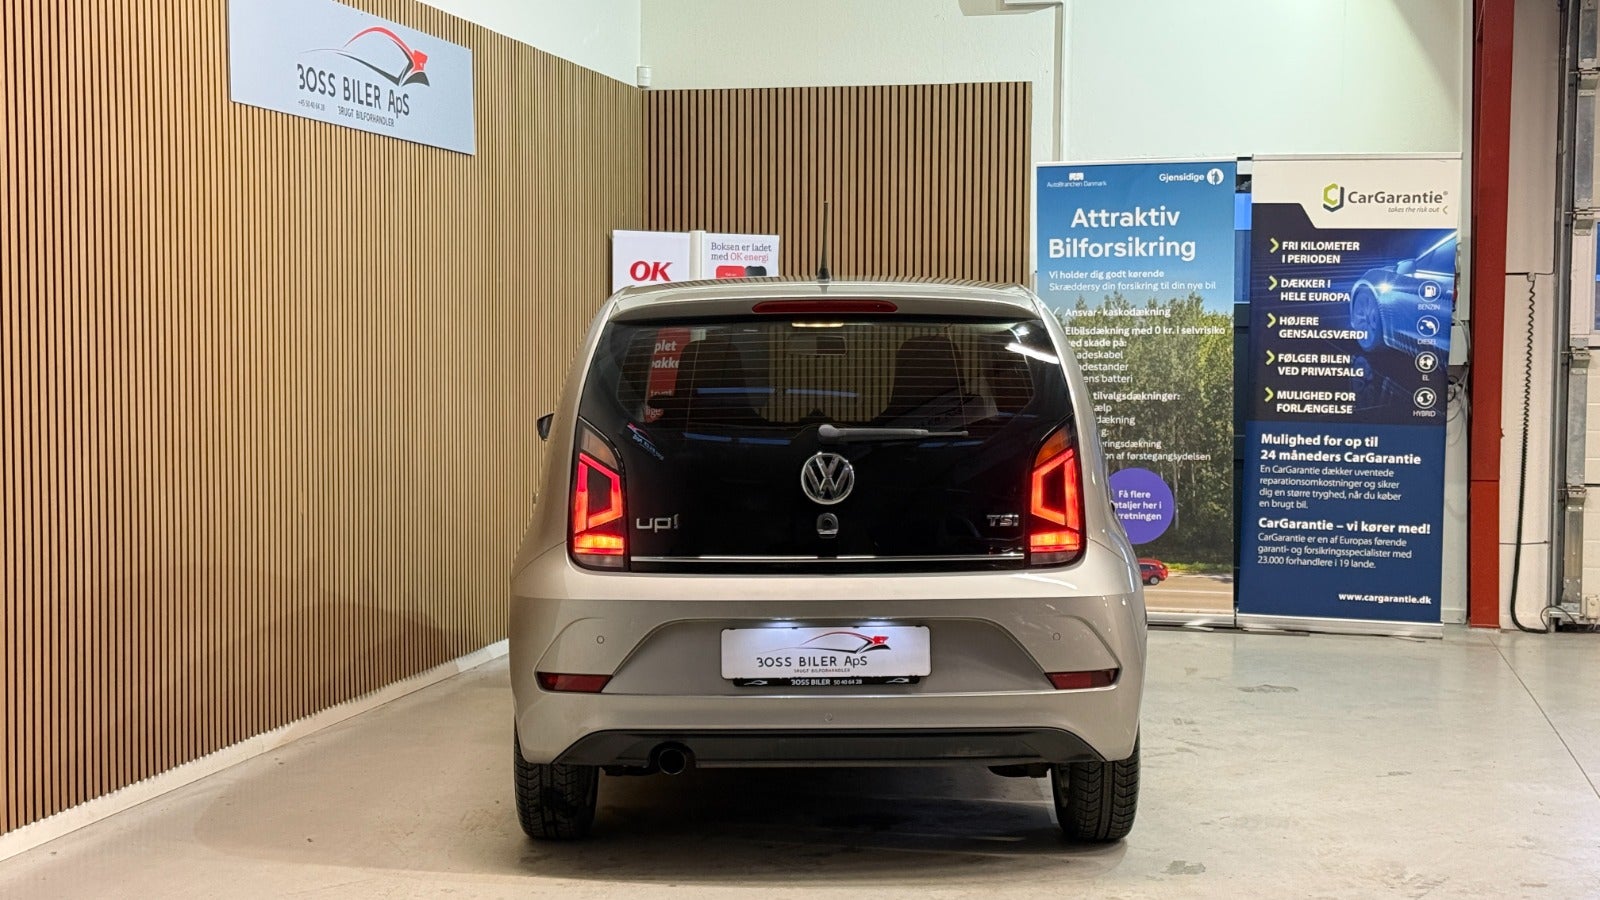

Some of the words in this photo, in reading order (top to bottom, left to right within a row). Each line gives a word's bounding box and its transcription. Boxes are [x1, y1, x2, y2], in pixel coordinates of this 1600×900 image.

[343, 76, 381, 109] BILER
[388, 89, 410, 118] ApS
[1159, 173, 1204, 182] Gjensidige
[1070, 206, 1180, 228] Attraktiv
[711, 242, 740, 250] Boksen
[752, 243, 772, 251] ladet
[1049, 235, 1196, 261] Bilforsikring
[1281, 241, 1298, 251] FRI
[1300, 241, 1360, 251] KILOMETER
[730, 252, 742, 260] OK
[744, 253, 768, 263] energi
[1287, 255, 1341, 264] PERIODEN
[629, 260, 673, 282] OK
[1049, 271, 1059, 279] Vi
[1060, 271, 1088, 279] holder
[1090, 271, 1105, 280] dig
[1106, 270, 1126, 280] godt
[1128, 270, 1165, 278] kørende
[1049, 283, 1100, 292] Skræddersy
[1102, 282, 1116, 290] din
[1118, 282, 1158, 291] forsikring
[1171, 281, 1185, 289] din
[1205, 281, 1216, 289] bil
[1281, 279, 1325, 288] DÆKKER
[1280, 293, 1306, 302] HELE
[1308, 292, 1350, 302] EUROPA
[1417, 303, 1441, 311] BENZIN
[1103, 307, 1171, 318] kaskodækning
[1279, 316, 1319, 326] HØJERE
[1065, 326, 1130, 337] Elbilsdækning
[1131, 327, 1153, 335] med
[1154, 326, 1161, 335] 0
[1163, 326, 1175, 335] kr.
[1181, 326, 1226, 335] selvrisiko
[1278, 330, 1368, 340] GENSALGSVÆRDI
[1083, 339, 1111, 347] skade
[1113, 338, 1127, 348] på:
[1077, 350, 1124, 360] adeskabel
[1278, 353, 1319, 364] FØLGER
[1320, 354, 1350, 363] BILEN
[1079, 363, 1129, 371] destander
[1277, 367, 1299, 376] VED
[1301, 367, 1364, 377] PRIVATSALG
[1102, 374, 1133, 383] batteri
[1093, 392, 1181, 401] tilvalgsdækninger:
[1276, 390, 1333, 401] MULIGHED
[1335, 391, 1356, 401] FOR
[1094, 404, 1112, 413] ælp
[1276, 404, 1353, 414] FORLÆNGELSE
[1096, 416, 1135, 426] dækning
[1103, 439, 1162, 449] ringsdækning
[1261, 433, 1321, 447] Mulighed
[1323, 435, 1342, 446] for
[1344, 438, 1363, 449] op
[1364, 436, 1378, 447] til
[1116, 450, 1125, 460] af
[1126, 451, 1211, 461] førstegangsydelsen
[1260, 450, 1276, 460] 24
[1279, 450, 1341, 462] måneders
[1344, 452, 1421, 465] CarGarantie
[1260, 465, 1271, 473] En
[1272, 465, 1320, 475] CarGarantie
[1322, 467, 1353, 476] dækker
[1354, 468, 1395, 477] uventede
[1259, 477, 1362, 489] reparationsomkostninger
[1364, 481, 1375, 489] og
[1377, 480, 1400, 489] sikrer
[1119, 490, 1129, 498] Få
[1130, 490, 1151, 498] flere
[1259, 488, 1273, 498] dig
[1287, 489, 1310, 498] større
[1312, 489, 1347, 500] tryghed,
[1348, 490, 1363, 499] når
[1364, 491, 1375, 500] du
[1377, 492, 1401, 500] køber
[1114, 501, 1141, 510] etaljer
[1143, 501, 1157, 509] her
[1271, 500, 1295, 509] brugt
[1296, 501, 1308, 509] bil.
[987, 514, 1019, 526] TSI
[1118, 512, 1162, 522] retningen
[1258, 517, 1333, 531] CarGarantie
[1346, 521, 1358, 531] vi
[1361, 521, 1396, 534] kører
[1398, 523, 1431, 535] med!
[1258, 533, 1306, 542] CarGarantie
[1307, 535, 1316, 543] er
[1317, 536, 1328, 544] en
[1330, 535, 1338, 544] af
[1340, 535, 1373, 546] Europas
[1374, 537, 1407, 547] førende
[1258, 545, 1289, 554] garanti-
[1291, 547, 1302, 555] og
[1304, 546, 1391, 558] forsikringsspecialister
[1392, 550, 1412, 558] med
[1257, 556, 1285, 564] 23.000
[1285, 557, 1333, 567] forhandlere
[1339, 559, 1350, 568] 19
[1351, 559, 1376, 568] lande.
[1338, 592, 1432, 605] www.cargarantie.dk
[799, 656, 837, 666] BILER
[844, 655, 868, 668] ApS
